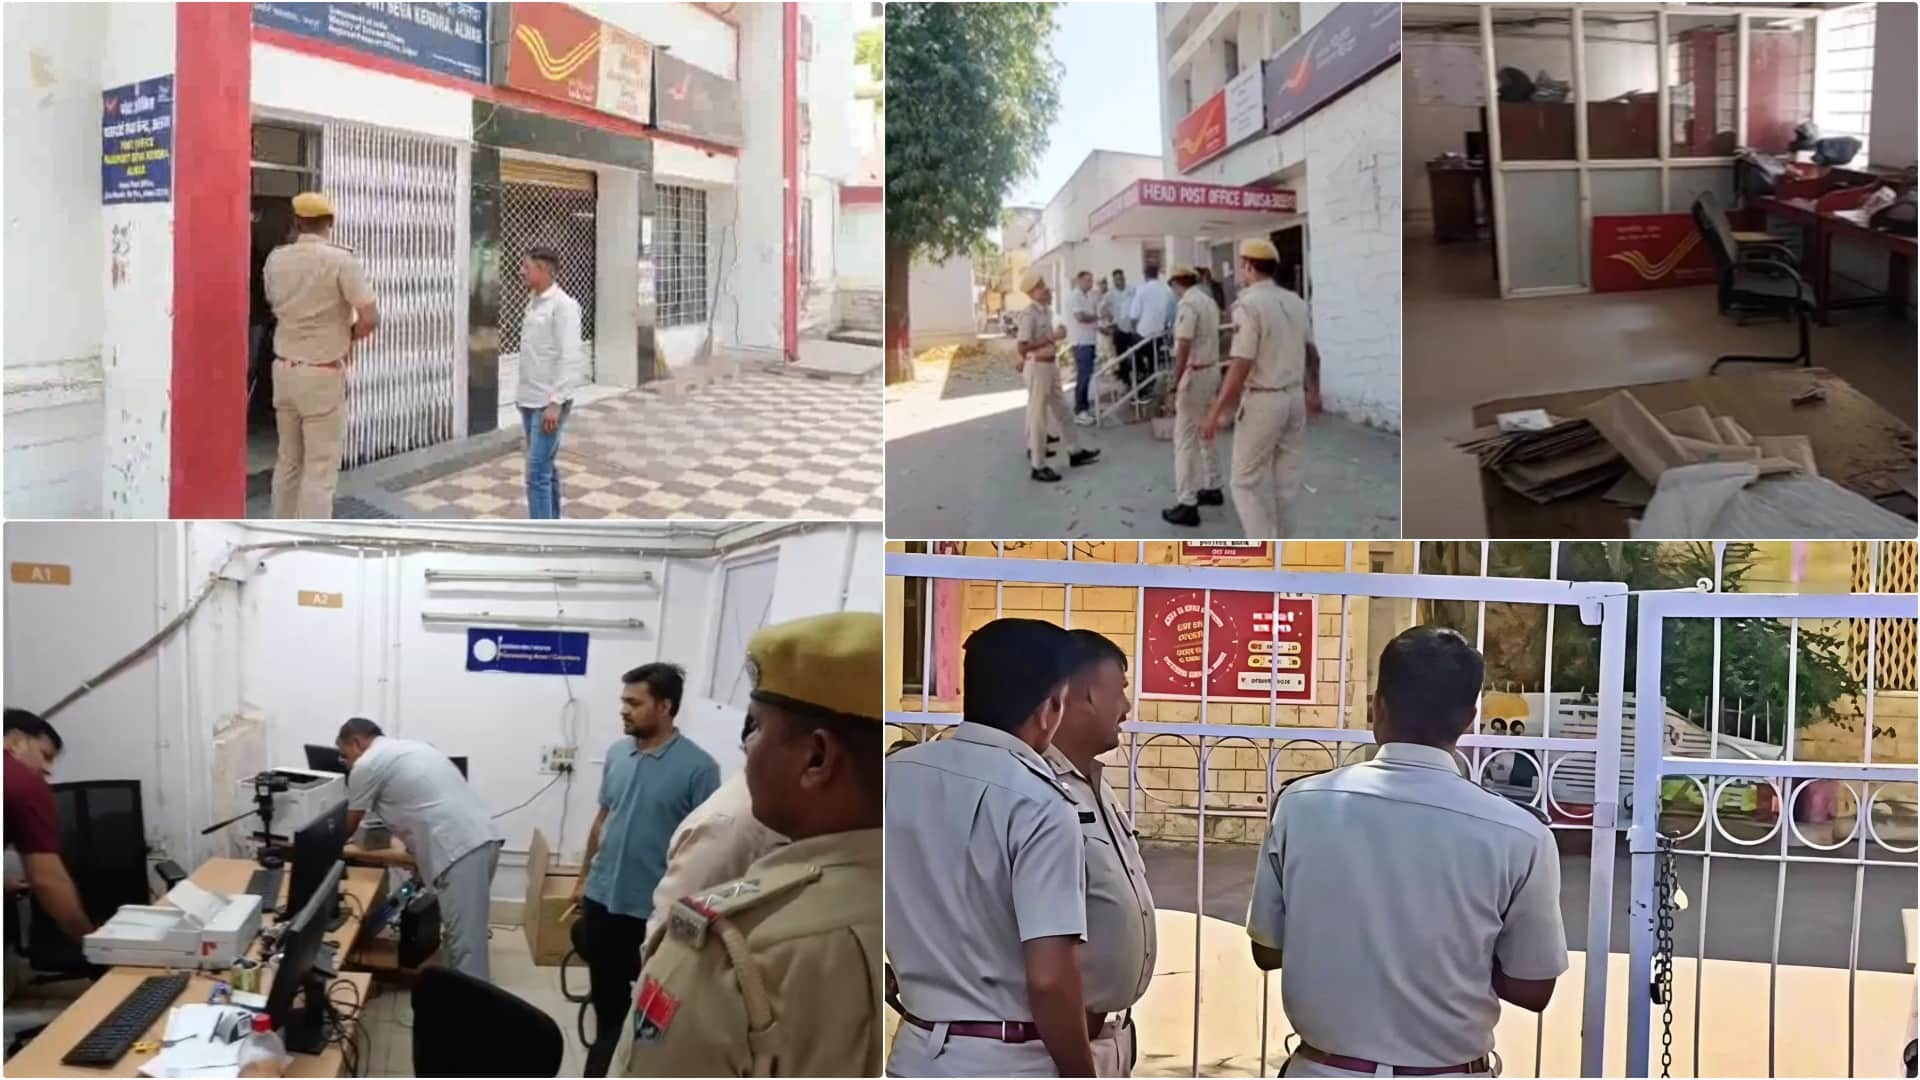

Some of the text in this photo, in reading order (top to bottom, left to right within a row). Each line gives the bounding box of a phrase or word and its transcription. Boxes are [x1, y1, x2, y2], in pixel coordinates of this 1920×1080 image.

[1143, 184, 1177, 202] HEAD
[1180, 186, 1206, 205] POST
[1207, 189, 1241, 206] OFFICE
[32, 567, 51, 582] A1
[312, 593, 329, 606] A2
